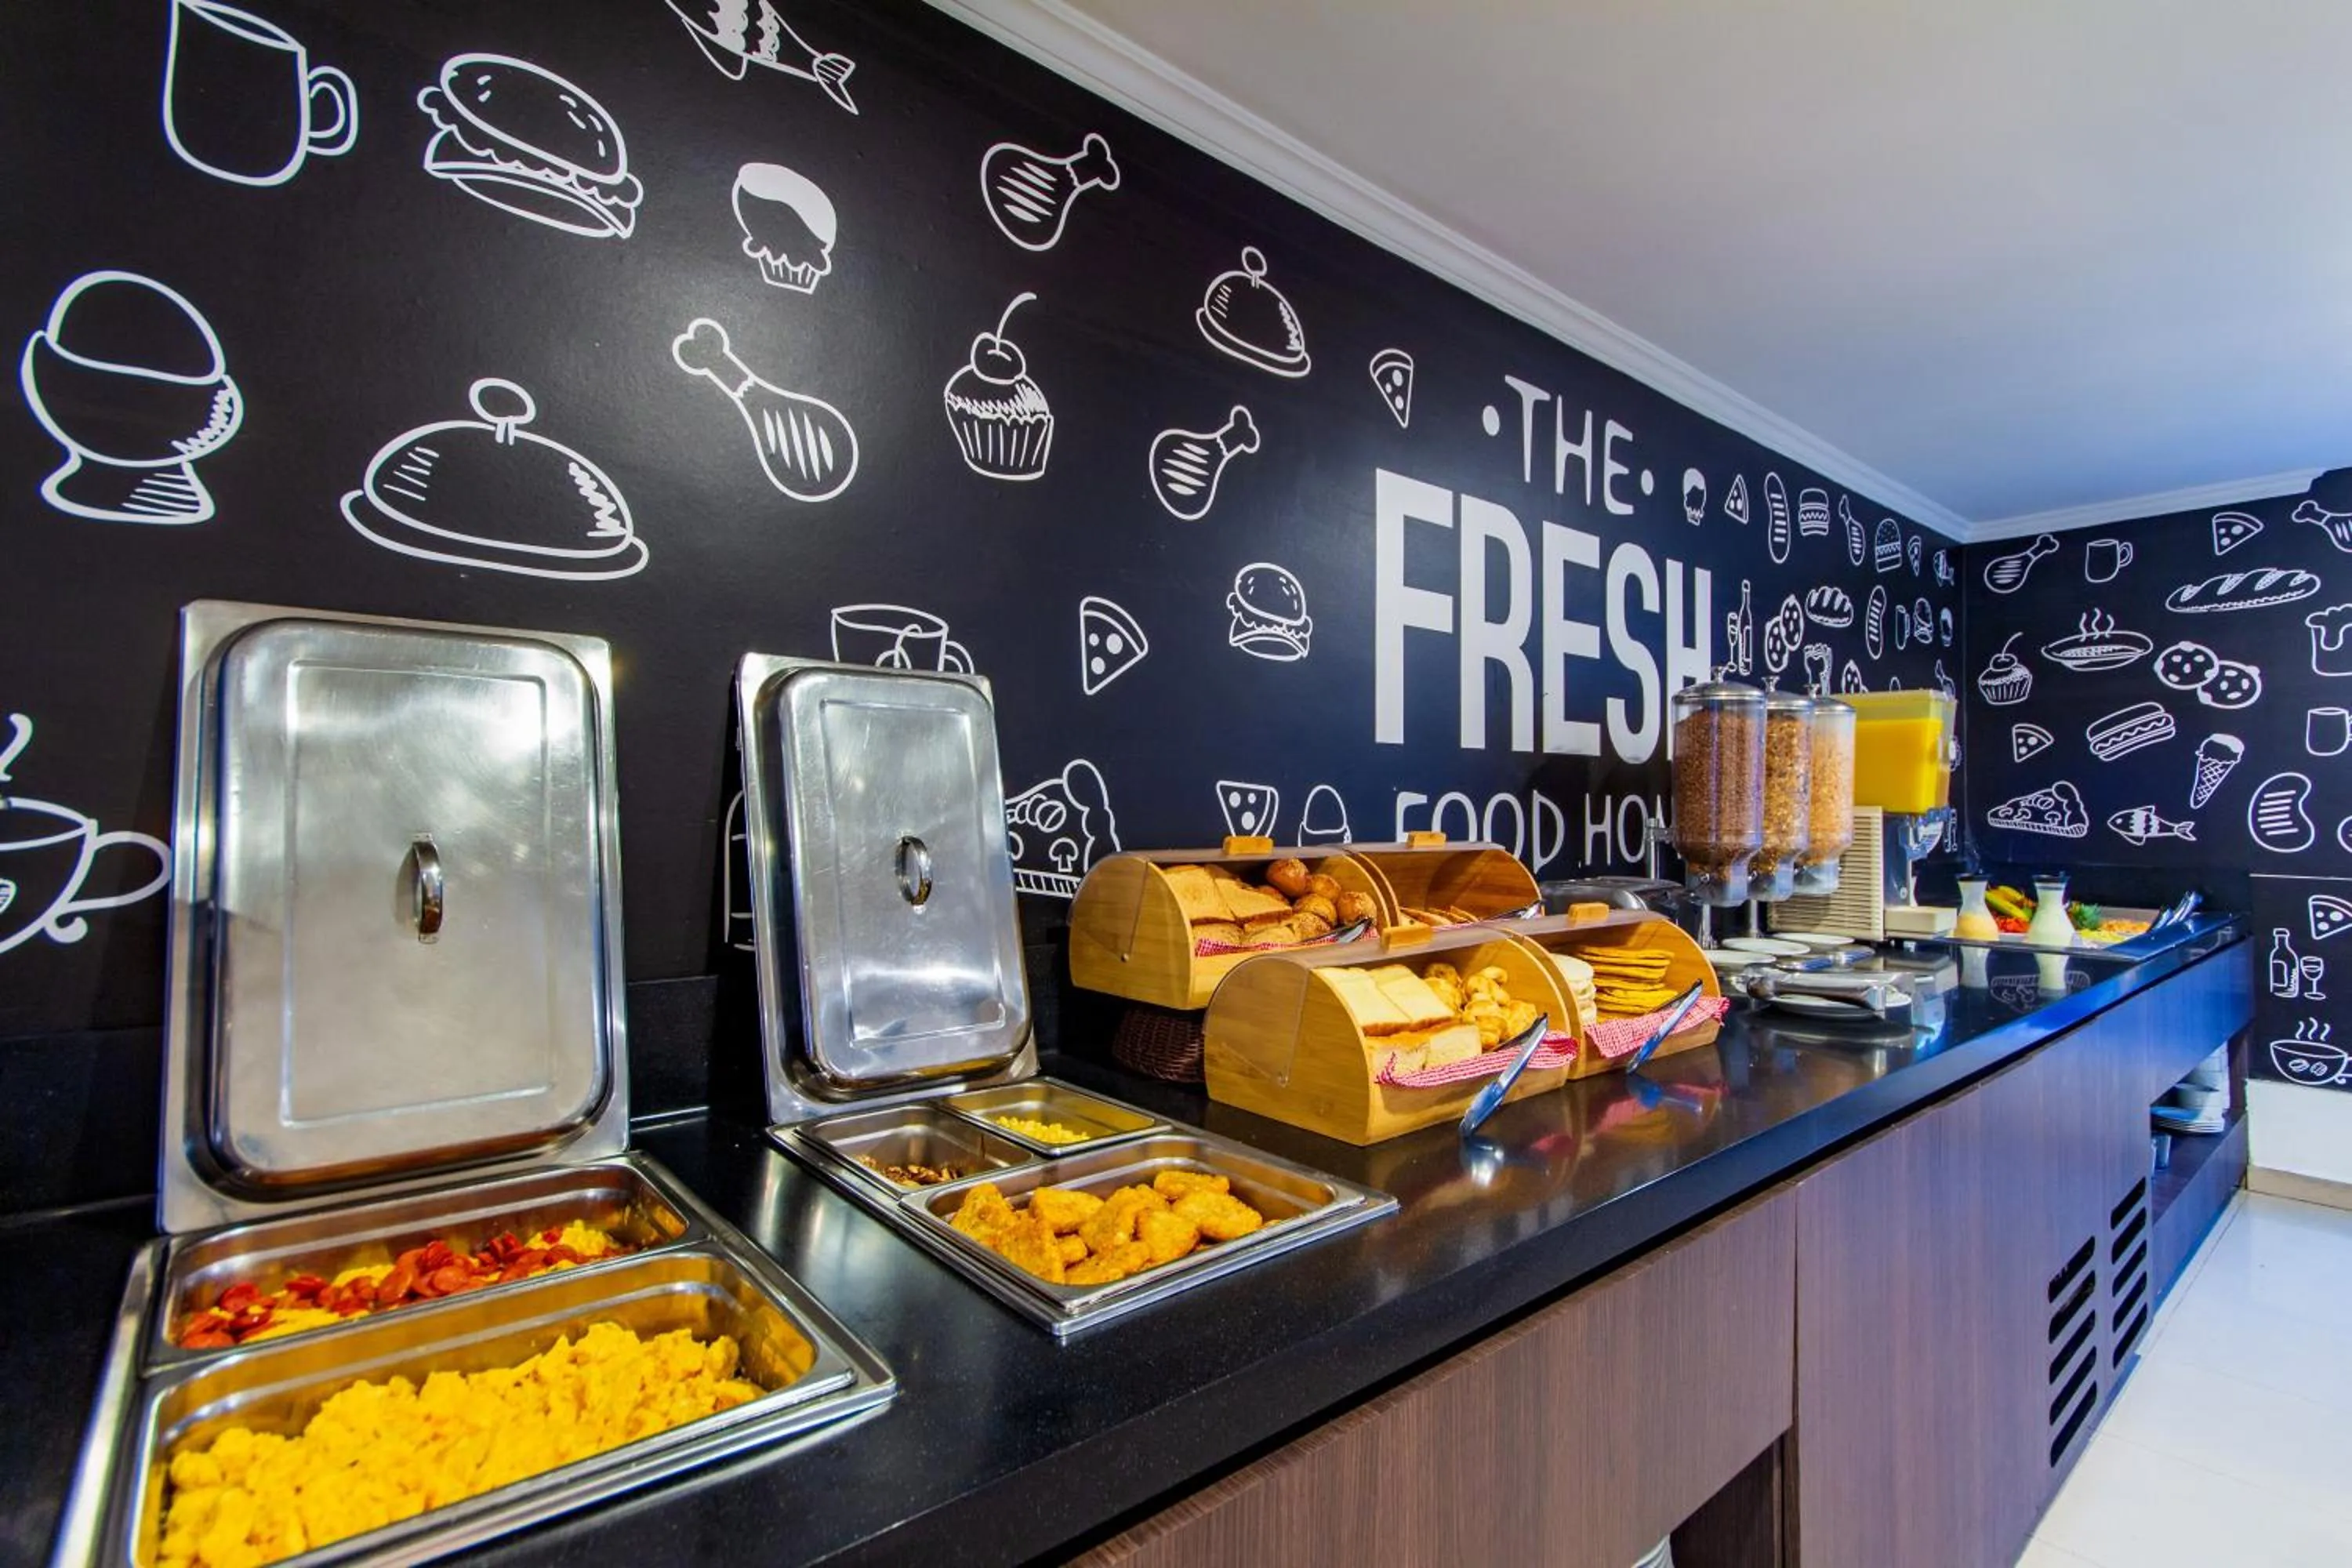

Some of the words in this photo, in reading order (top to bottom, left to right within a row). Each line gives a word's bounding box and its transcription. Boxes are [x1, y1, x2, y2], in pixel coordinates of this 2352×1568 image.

[1504, 374, 1634, 516] THE
[1376, 467, 1711, 764] FRESH
[1396, 789, 1565, 875] FOOD
